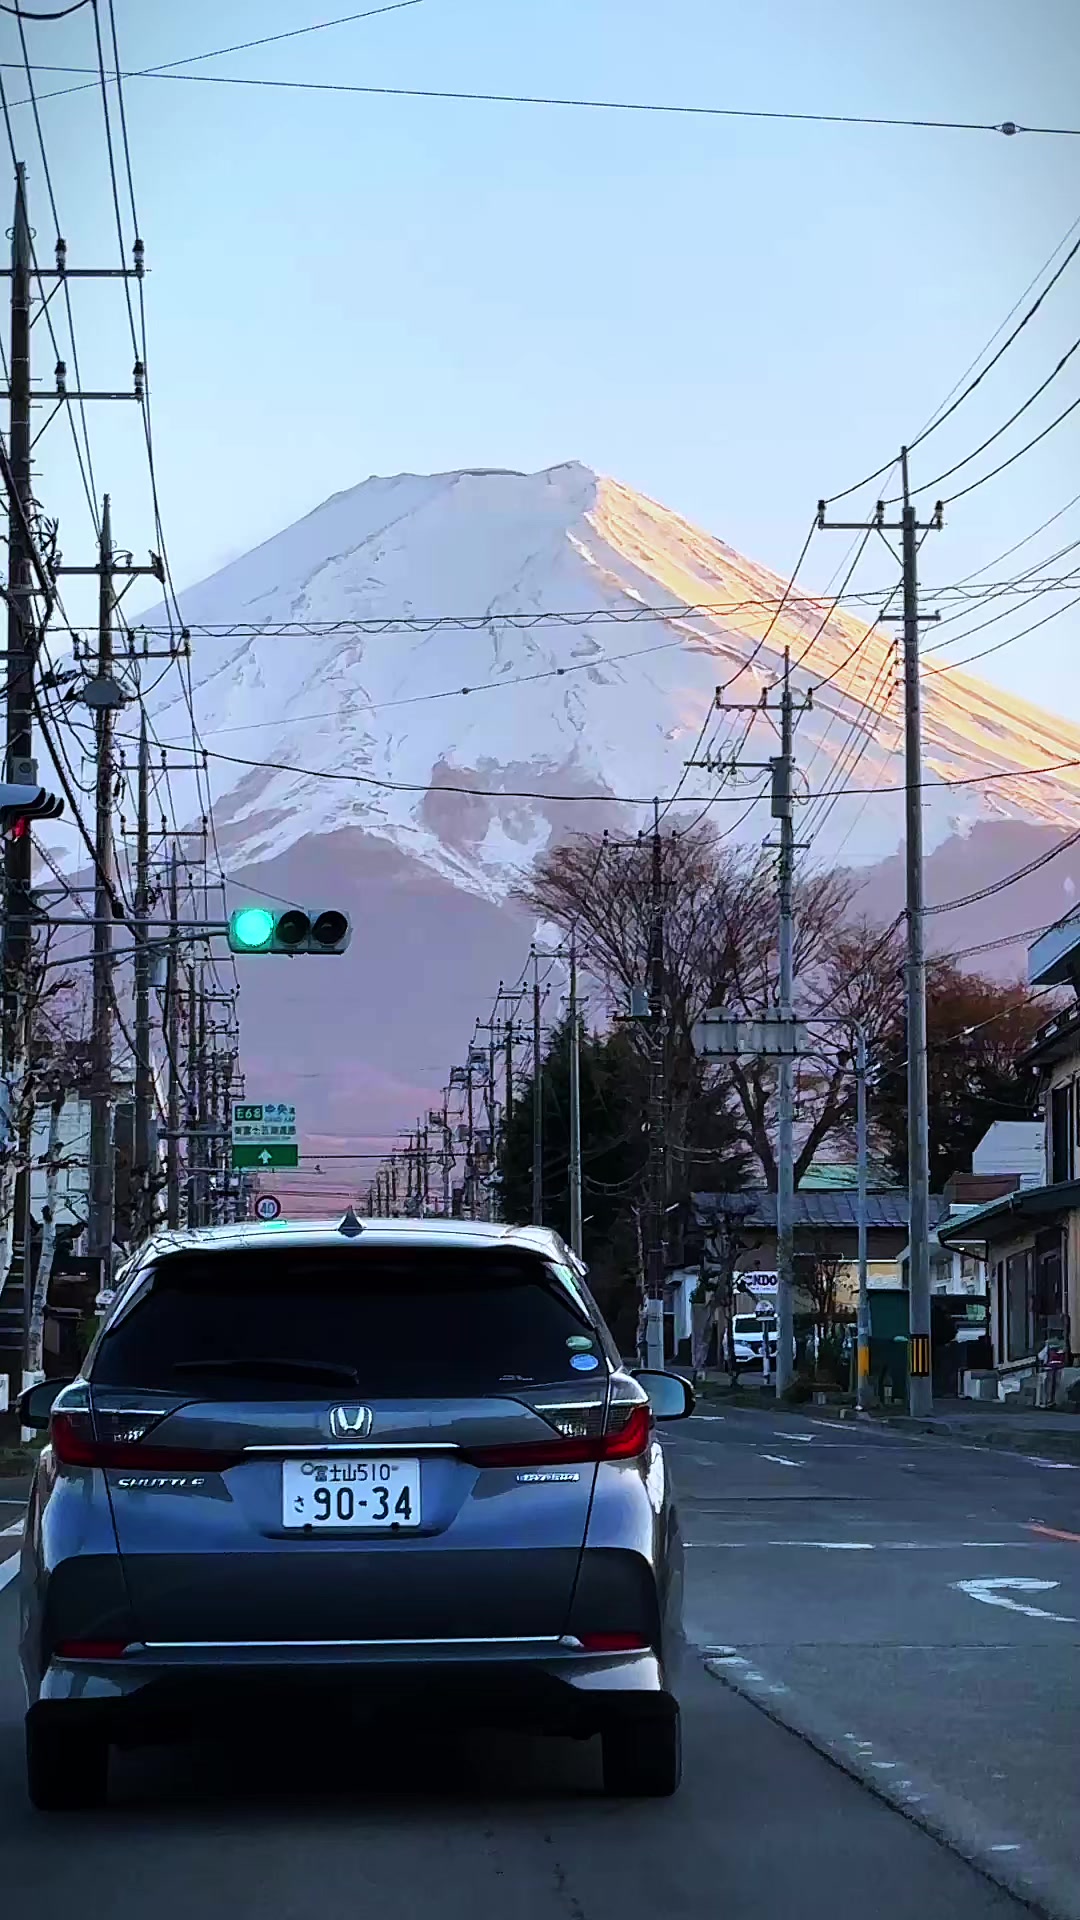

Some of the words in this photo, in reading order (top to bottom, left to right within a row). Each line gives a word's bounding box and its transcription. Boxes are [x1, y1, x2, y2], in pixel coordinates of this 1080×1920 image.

[236, 1108, 261, 1119] E68
[260, 1202, 275, 1213] 40
[118, 1478, 205, 1487] SHUTTLE
[294, 1495, 305, 1513] さ
[314, 1485, 412, 1521] 90-34
